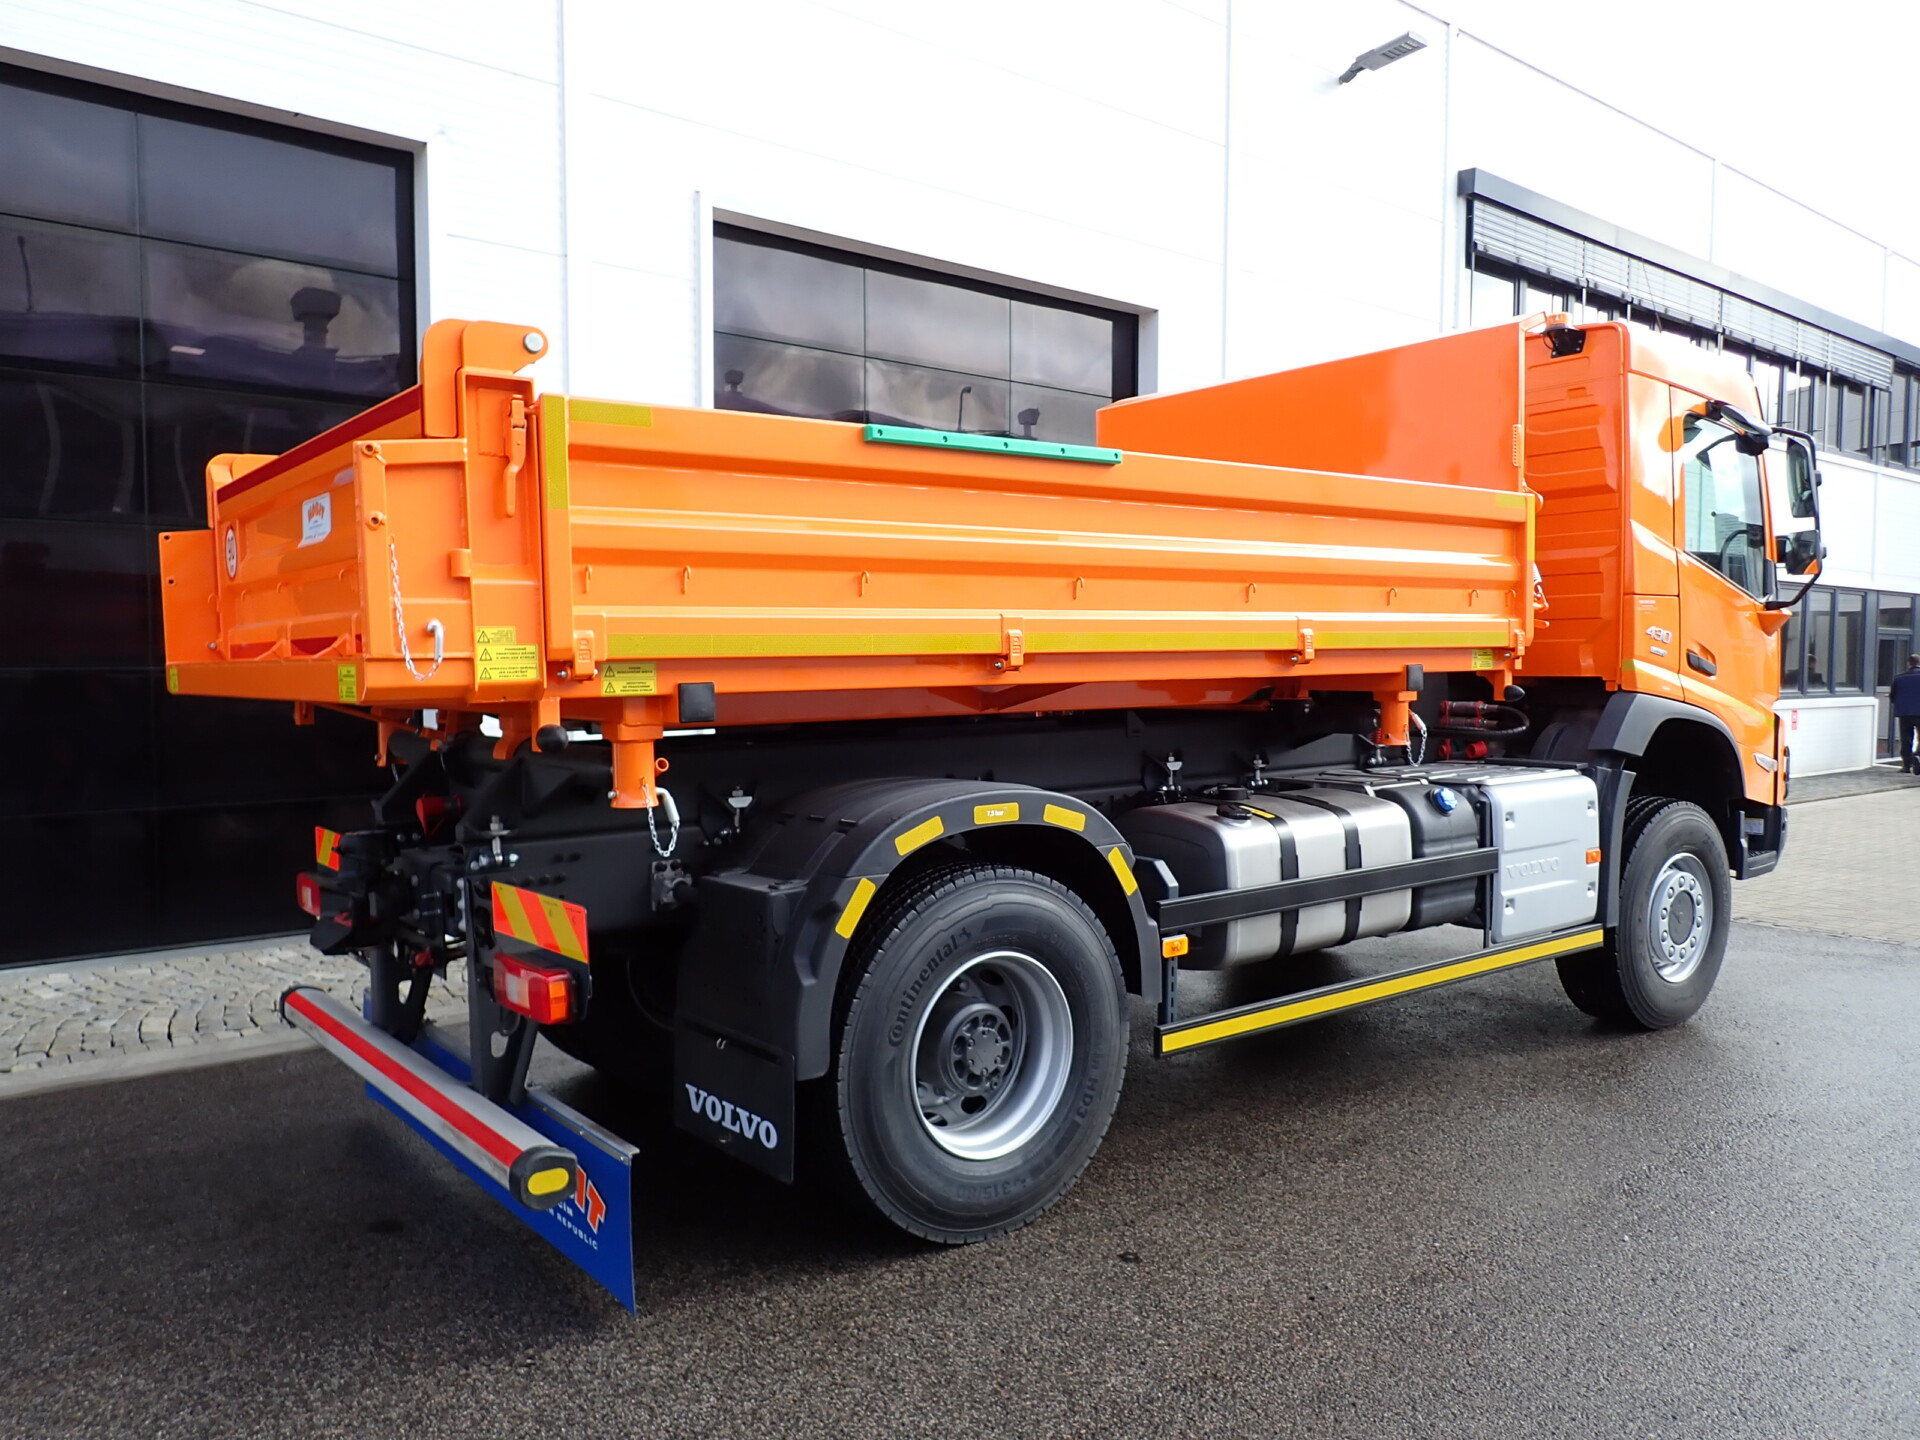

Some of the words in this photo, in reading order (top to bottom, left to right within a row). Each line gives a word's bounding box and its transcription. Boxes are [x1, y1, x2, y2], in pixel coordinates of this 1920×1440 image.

[1645, 626, 1672, 644] 430
[1506, 856, 1560, 879] VOLVO
[888, 934, 959, 1047] Continental
[685, 1082, 778, 1149] VOLVO
[556, 1212, 598, 1250] REPUBLIC
